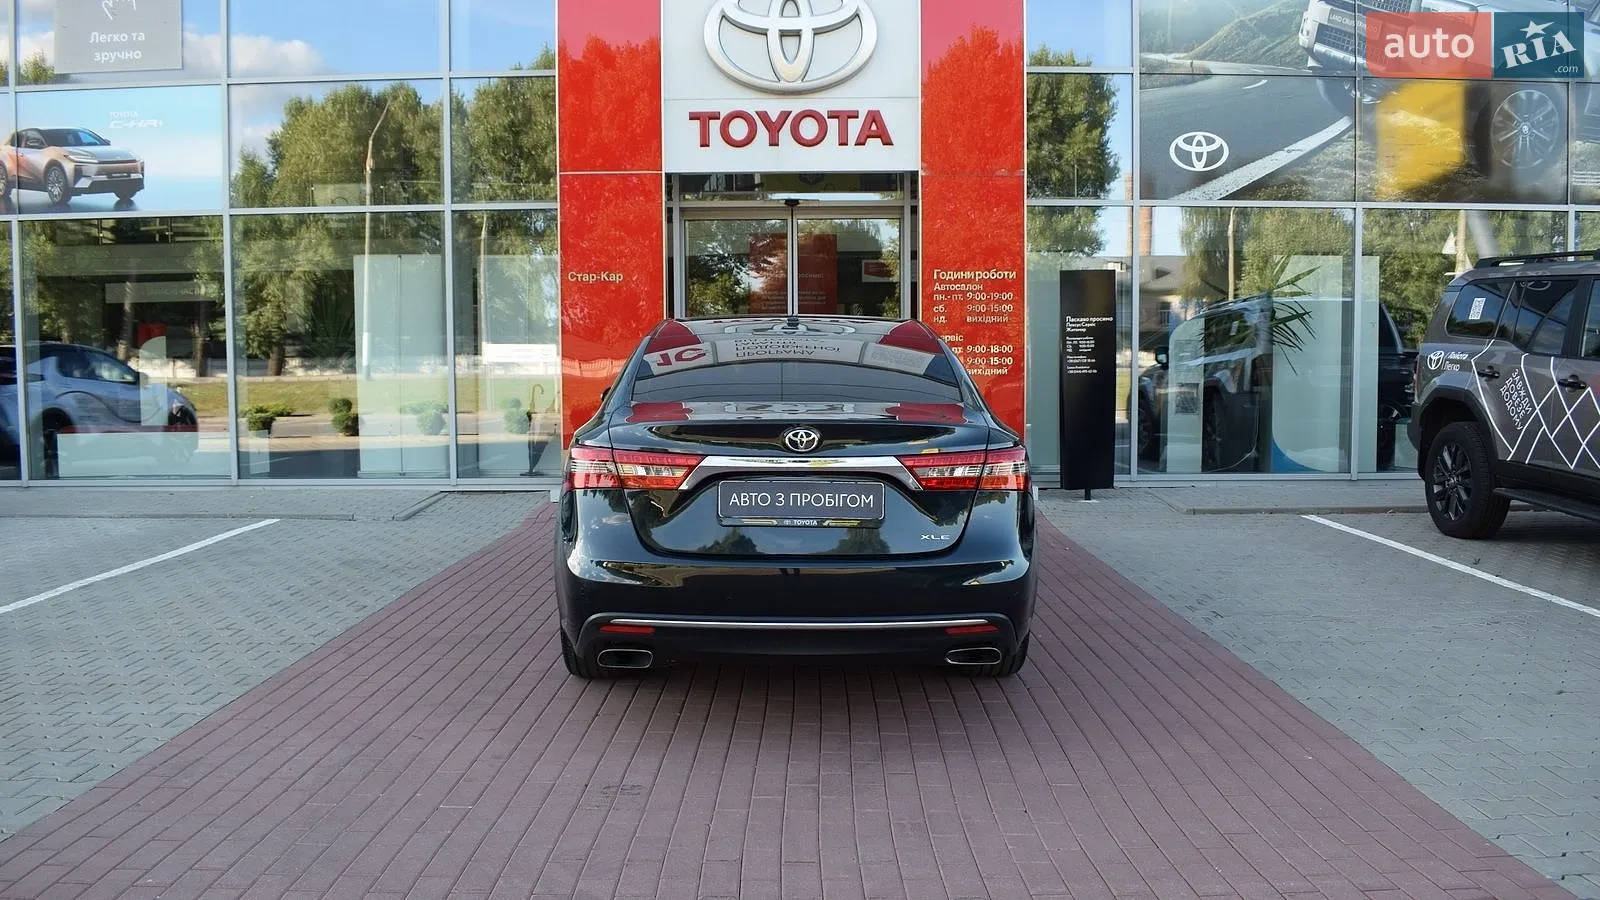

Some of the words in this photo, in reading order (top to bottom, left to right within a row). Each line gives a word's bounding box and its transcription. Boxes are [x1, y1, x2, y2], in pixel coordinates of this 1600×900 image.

[88, 31, 128, 44] Легко
[131, 31, 146, 41] та
[93, 50, 142, 64] зручно
[688, 109, 894, 148] TOYOTA
[567, 271, 624, 284] Стар-Кар
[933, 269, 975, 281] Години
[975, 268, 1017, 282] роботи
[933, 282, 983, 291] Автосалон
[933, 304, 948, 313] сб.
[933, 315, 948, 323] нд.
[966, 313, 1009, 324] вихідний
[1504, 377, 1526, 418] ДОВЕЗЕ
[1511, 368, 1532, 415] ЗАВЖДИ
[1500, 384, 1523, 430] ДОДОМУ
[728, 492, 771, 507] АВТО
[775, 493, 785, 507] З
[789, 493, 874, 508] ПРОБІГОМ
